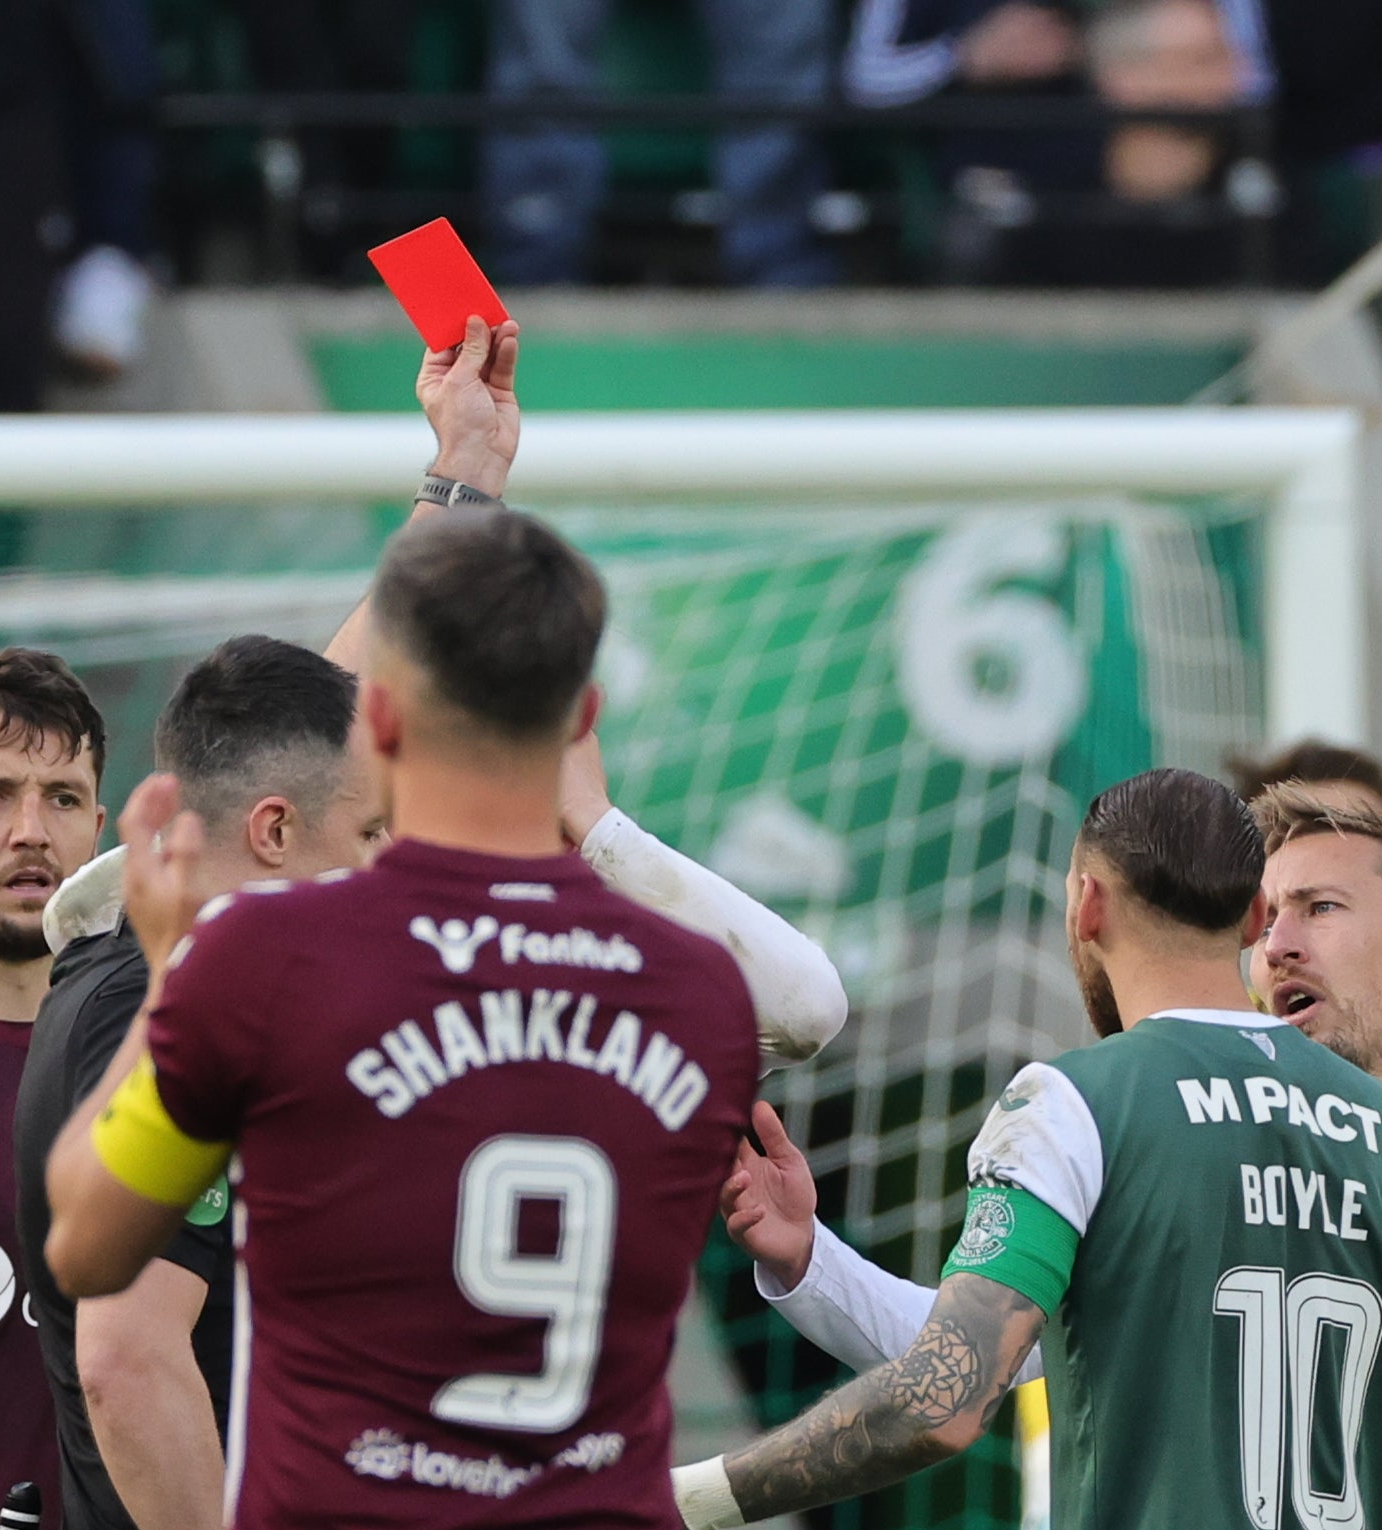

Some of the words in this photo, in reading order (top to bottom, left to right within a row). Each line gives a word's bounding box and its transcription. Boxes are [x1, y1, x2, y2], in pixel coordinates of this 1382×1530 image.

[345, 989, 708, 1131] SHANKLAND
[1240, 1163, 1368, 1241] BOYLE
[429, 1133, 617, 1434] 9
